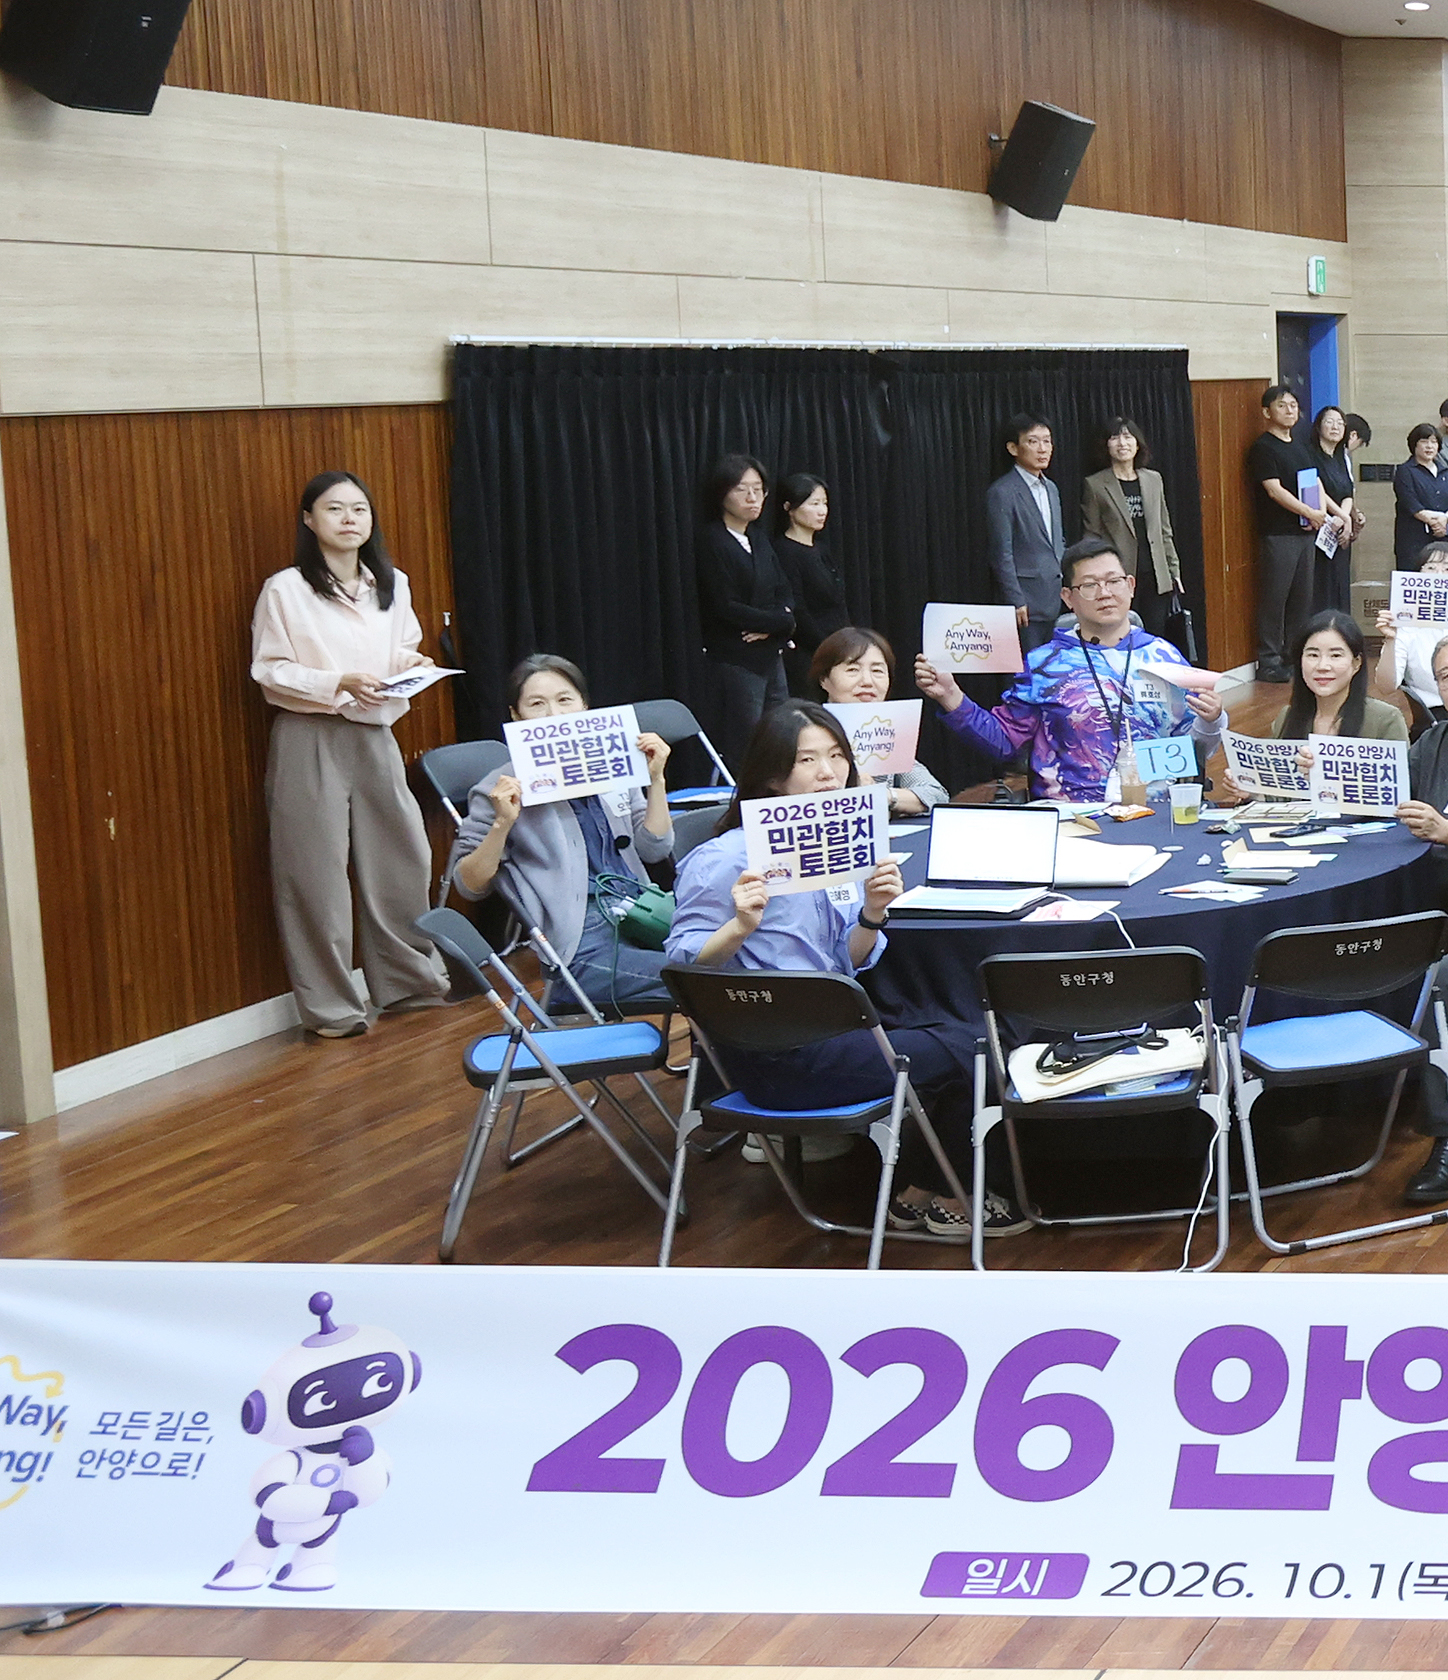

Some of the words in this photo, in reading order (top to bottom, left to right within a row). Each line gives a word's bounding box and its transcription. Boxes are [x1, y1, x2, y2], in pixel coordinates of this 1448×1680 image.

[1401, 577, 1431, 588] 2026
[945, 629, 965, 641] Any
[965, 629, 991, 640] Way,
[950, 641, 993, 653] Anyang!
[521, 722, 571, 742] 2026
[575, 714, 624, 734] 안양시
[853, 730, 873, 741] Any
[875, 727, 895, 740] Way,
[530, 731, 629, 767] 민관협치
[856, 742, 895, 757] Anyang!
[1138, 743, 1187, 774] T3
[1229, 737, 1264, 754] 2026
[1318, 743, 1355, 757] 2026
[1358, 745, 1396, 761] 안양시
[562, 755, 634, 786] 토론회
[1322, 759, 1398, 784] 민관협치
[1343, 783, 1399, 806] 토론회
[759, 803, 817, 824] 2026
[822, 794, 873, 817] 안양시
[768, 815, 874, 855] 민관협치
[800, 842, 875, 879] 토론회
[1334, 938, 1383, 956] 동안구청
[1060, 971, 1114, 987] 동안구청
[526, 1323, 1121, 1503] 2026
[76, 1448, 206, 1480] 안양으로!
[962, 1558, 1050, 1595] 일시
[1100, 1560, 1254, 1598] 2026.
